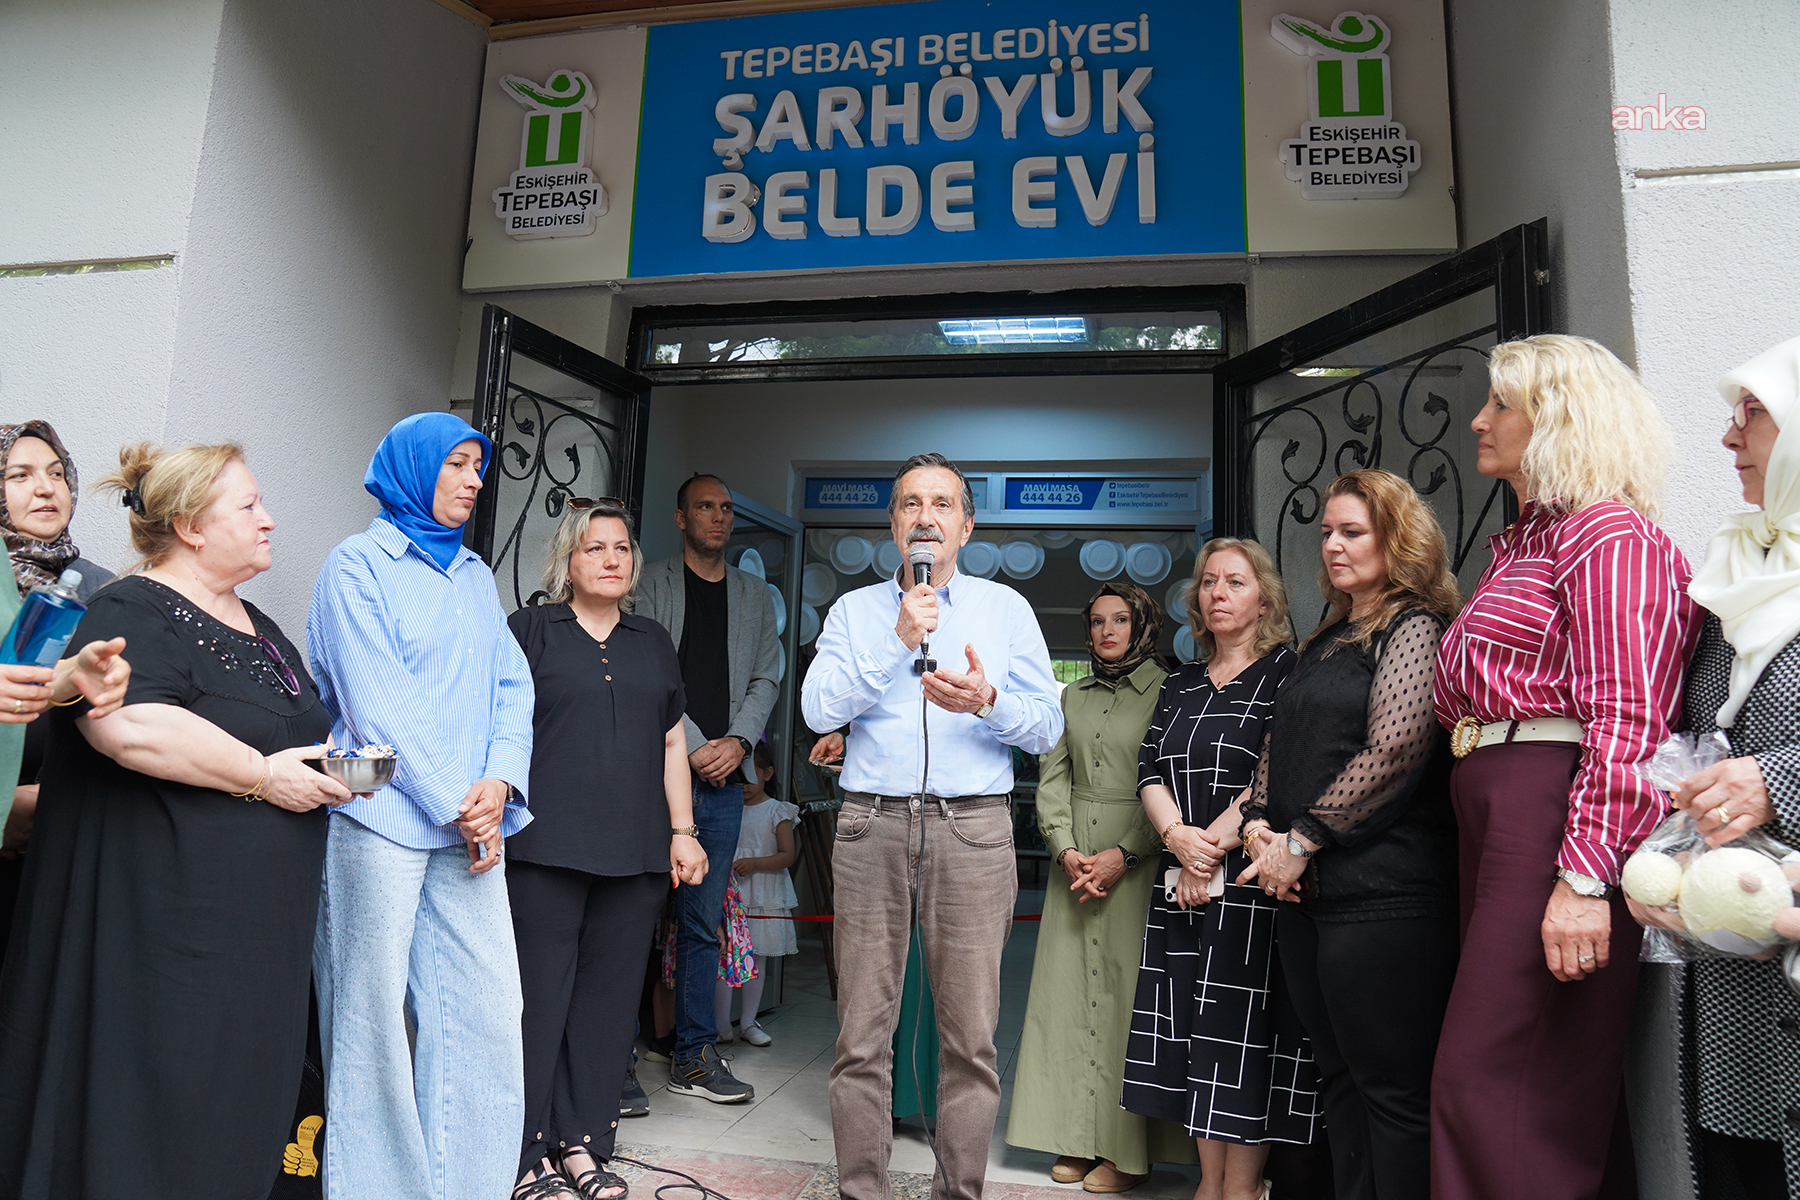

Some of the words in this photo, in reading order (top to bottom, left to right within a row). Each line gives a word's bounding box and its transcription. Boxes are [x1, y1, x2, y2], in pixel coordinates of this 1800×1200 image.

[720, 36, 905, 80] TEPEBAŞI
[917, 13, 1150, 66] BELEDİYESİ
[712, 55, 1154, 171] ŞARHÖYÜK
[1309, 125, 1401, 143] ESKİŞEHİR
[1289, 144, 1416, 168] TEPEBAŞI
[515, 171, 589, 190] ESKİŞEHİR
[1311, 170, 1403, 186] BELEDİYESİ
[702, 160, 976, 243] BELDE
[1011, 132, 1157, 229] EVİ
[498, 189, 598, 212] TEPEBAŞI
[511, 212, 585, 230] BELEDİYESİ
[822, 483, 847, 492] MAVİ
[847, 484, 876, 492] MASA
[1023, 482, 1049, 492] MAVİ
[1050, 484, 1079, 492] MASA
[820, 493, 842, 502] 444
[844, 493, 860, 502] 44
[861, 493, 877, 502] 26
[1022, 493, 1045, 502] 444
[1047, 493, 1063, 502] 44
[1065, 493, 1081, 502] 26
